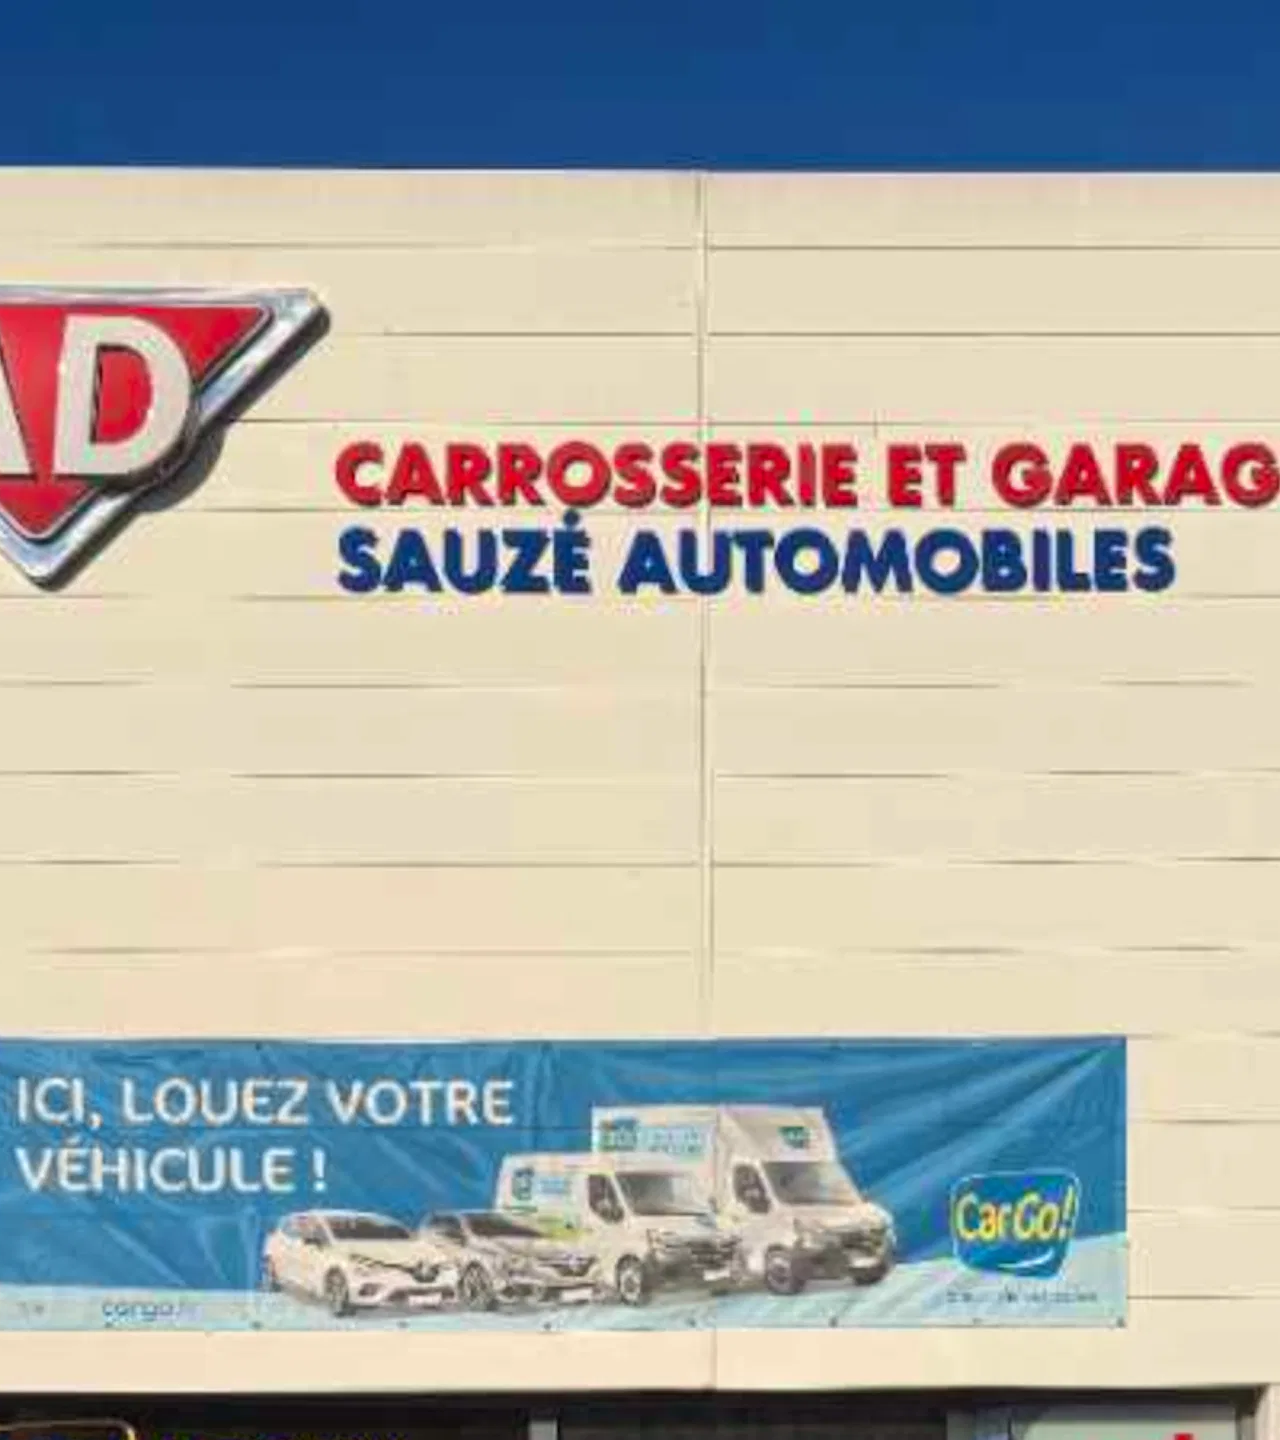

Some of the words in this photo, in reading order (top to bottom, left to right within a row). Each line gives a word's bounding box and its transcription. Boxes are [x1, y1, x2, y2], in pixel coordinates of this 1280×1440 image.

[334, 441, 858, 508] CARROSSERIE
[886, 443, 966, 508] ET
[337, 507, 592, 594] SAUZÉ
[619, 526, 1177, 595] AUTOMOBILES
[16, 1077, 102, 1129] ICI,
[121, 1078, 309, 1125] LOUEZ
[326, 1080, 515, 1126] VOTRE
[13, 1137, 296, 1193] VÉHICULE
